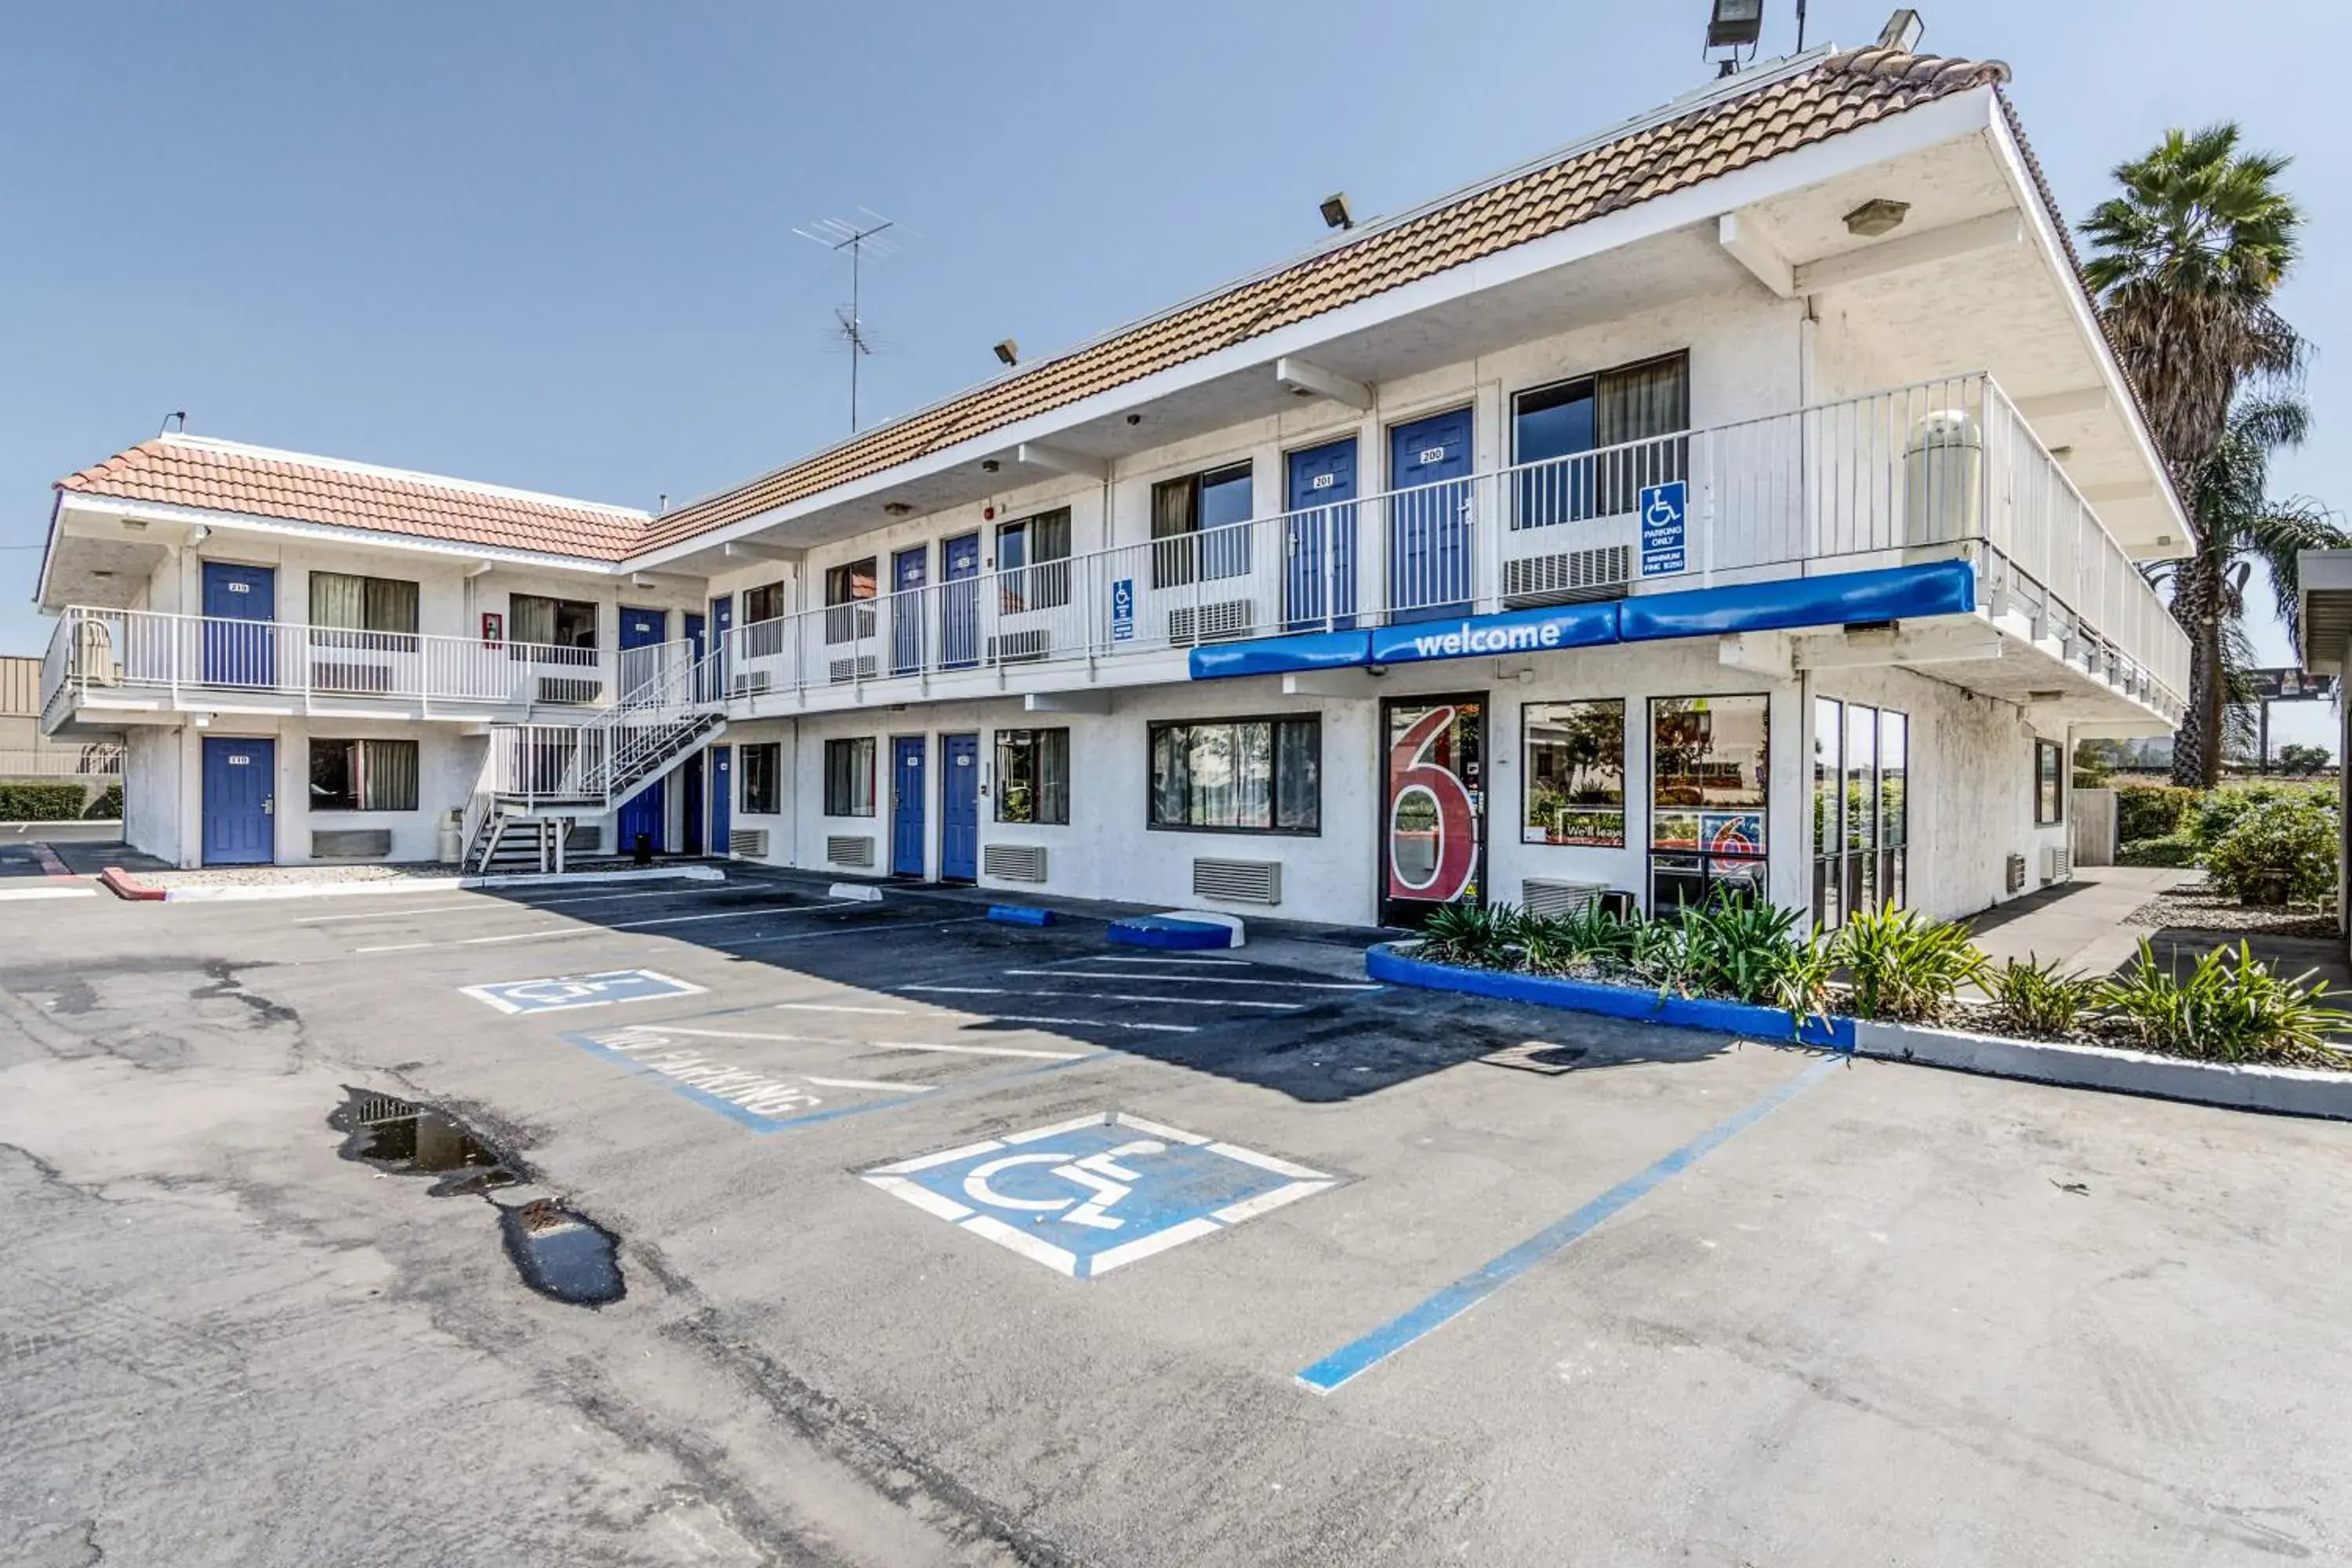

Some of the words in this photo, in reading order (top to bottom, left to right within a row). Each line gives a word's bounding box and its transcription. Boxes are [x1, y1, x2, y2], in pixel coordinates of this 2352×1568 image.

[1423, 449, 1442, 462] 200
[1316, 476, 1330, 487] 201
[1644, 525, 1682, 539] PARKING
[1652, 536, 1674, 546] ONLY
[1647, 552, 1681, 563] MINIMUM
[1415, 622, 1561, 656] welcome
[1391, 705, 1479, 902] 6
[1566, 823, 1594, 837] We'll
[1710, 816, 1753, 872] 6
[593, 1027, 671, 1051] NO
[632, 1048, 822, 1114] PARKING
